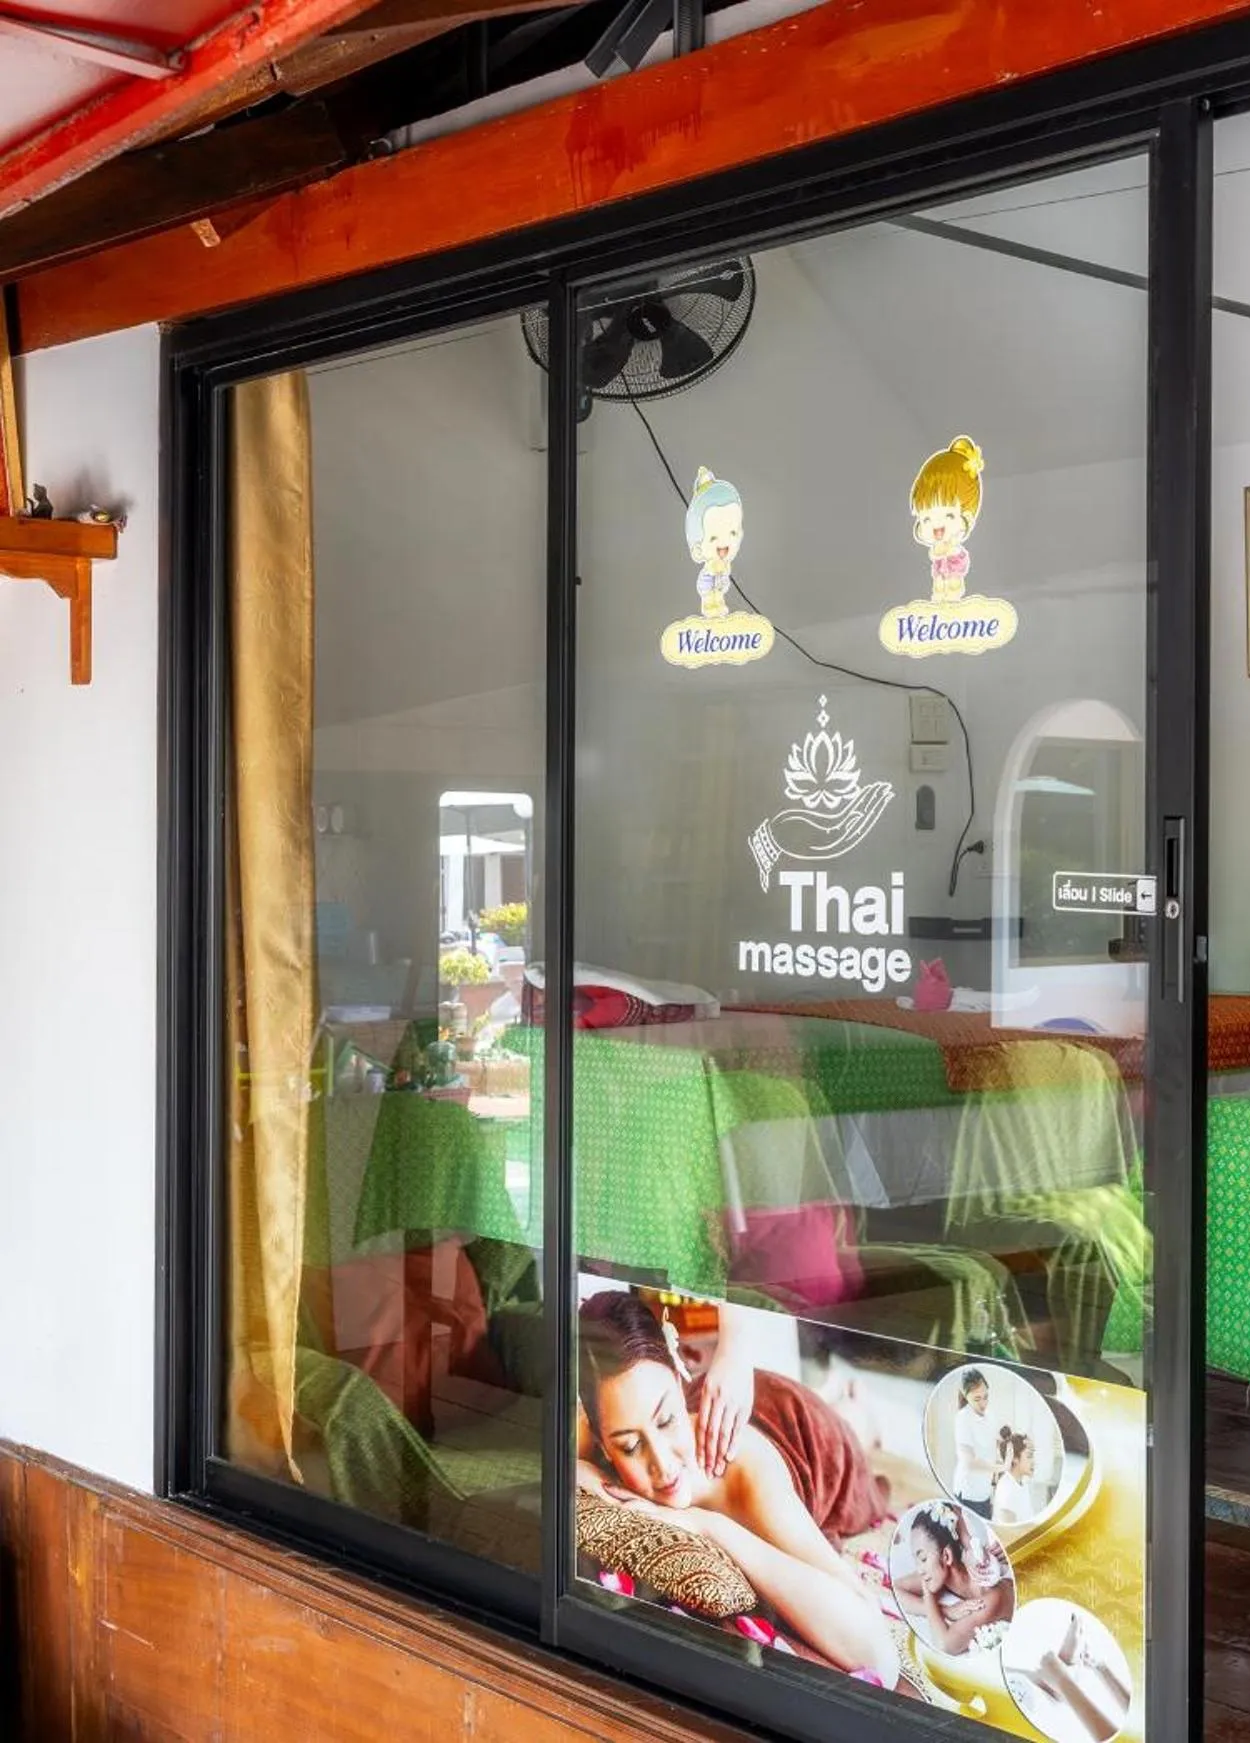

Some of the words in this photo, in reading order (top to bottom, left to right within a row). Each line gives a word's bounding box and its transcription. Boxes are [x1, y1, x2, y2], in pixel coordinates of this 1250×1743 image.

[678, 629, 762, 653] Welcome
[898, 614, 999, 642] Welcome
[779, 871, 904, 935] Thai
[1099, 887, 1132, 903] Slide
[738, 940, 912, 993] massage
